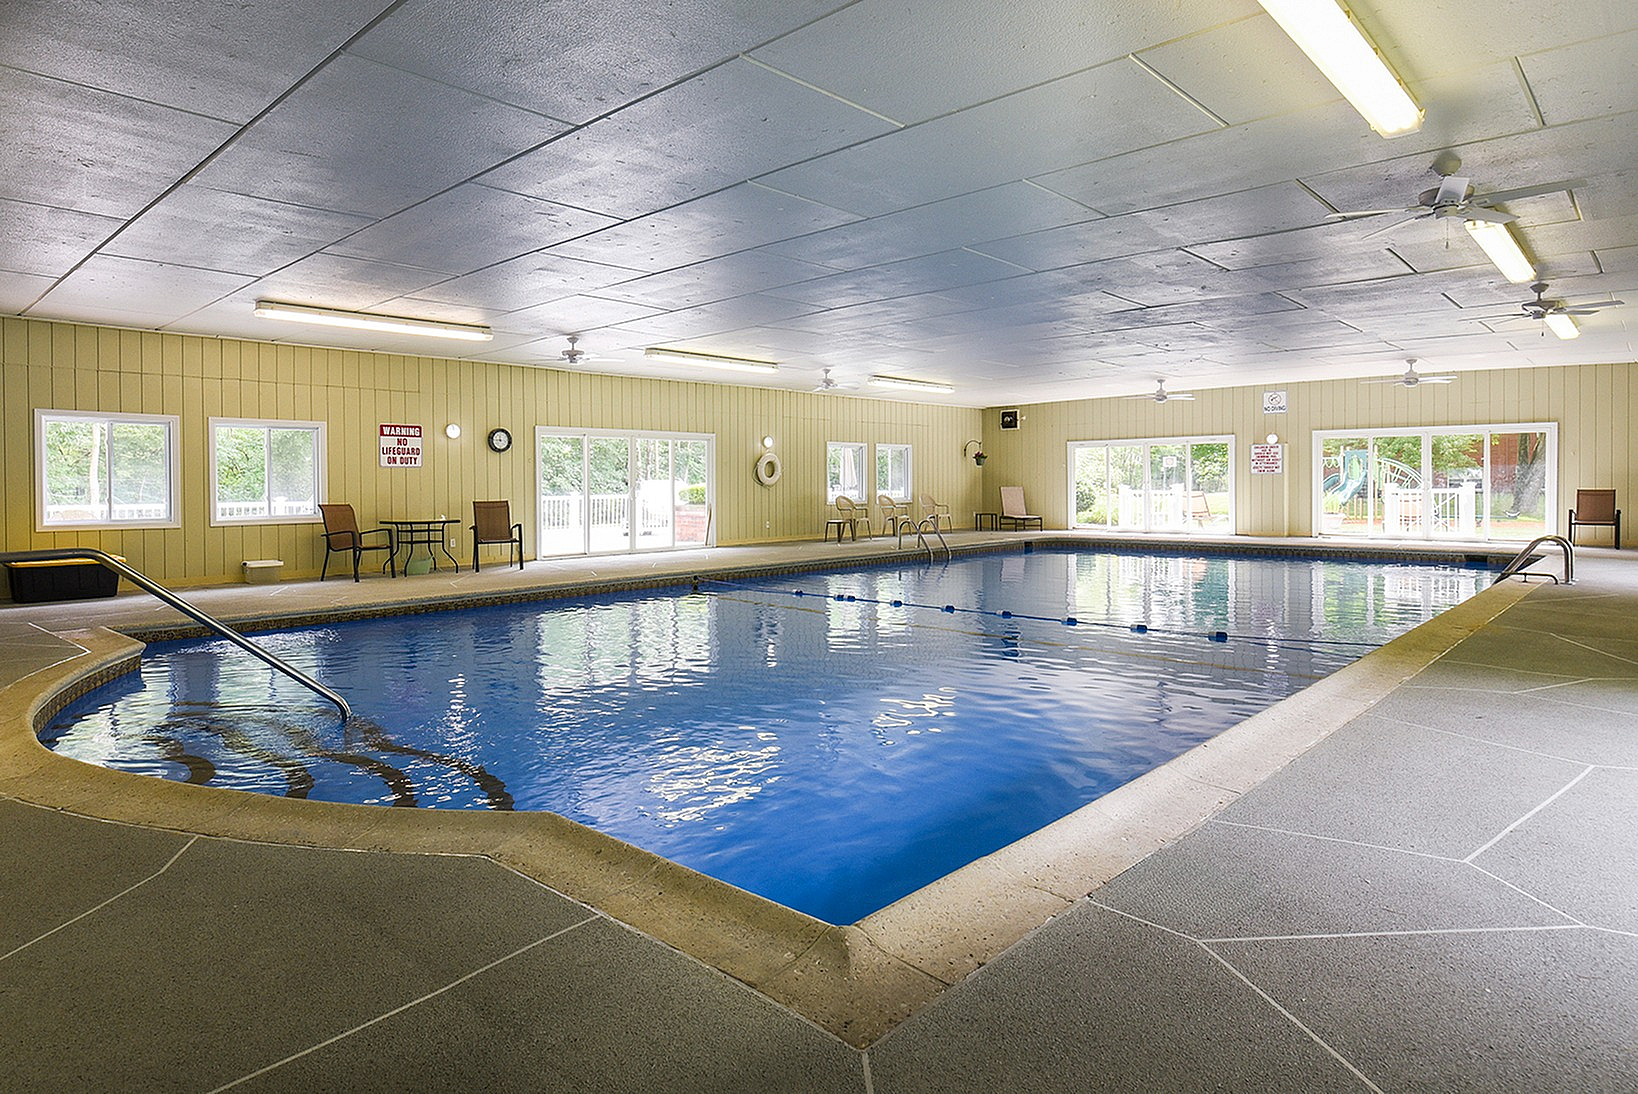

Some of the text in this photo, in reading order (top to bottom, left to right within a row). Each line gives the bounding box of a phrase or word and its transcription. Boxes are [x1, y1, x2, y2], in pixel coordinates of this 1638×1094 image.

[382, 426, 420, 436] WARNING
[397, 438, 408, 446] NO
[382, 447, 420, 456] LIFEGUARD
[387, 456, 418, 465] ON DUTY
